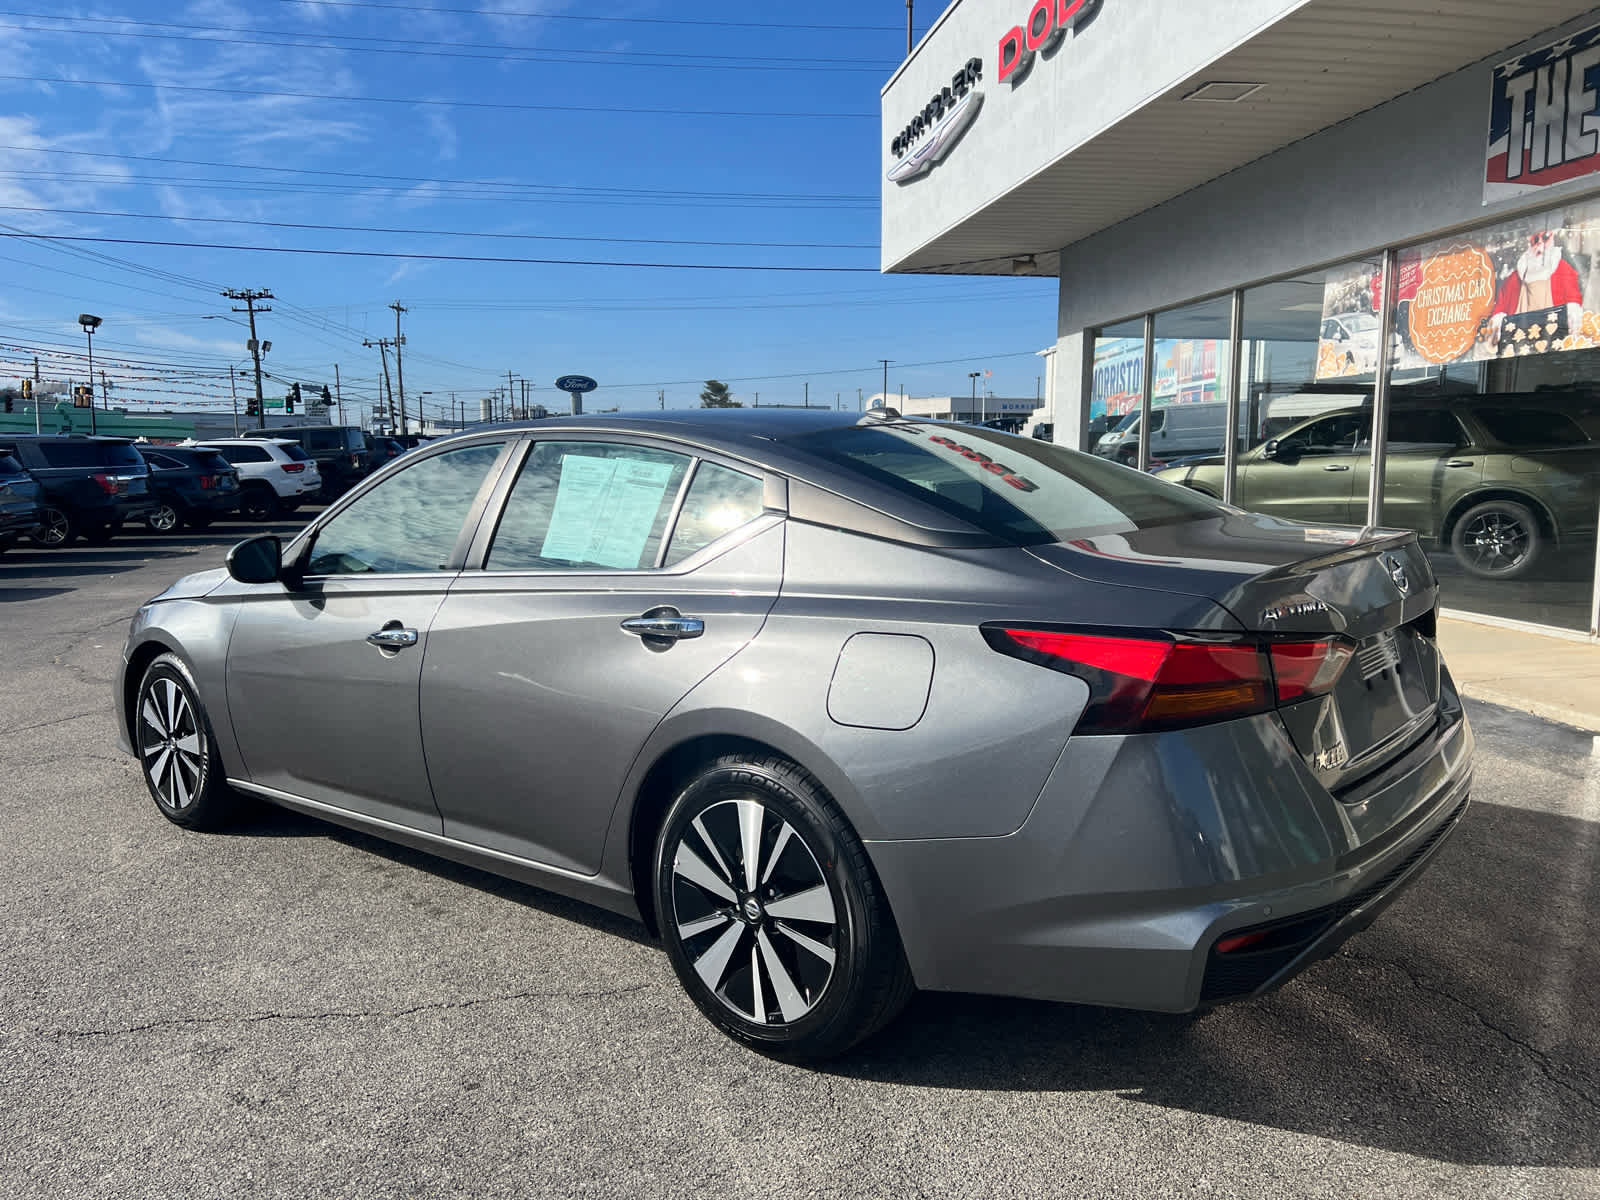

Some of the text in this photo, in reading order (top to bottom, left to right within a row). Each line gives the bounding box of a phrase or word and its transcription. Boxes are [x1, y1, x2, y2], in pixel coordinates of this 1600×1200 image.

[891, 57, 983, 158] CHRYSLER
[1505, 48, 1600, 180] THE
[1417, 281, 1466, 308] CHRISTMAS
[1467, 278, 1487, 300] CAR
[1427, 301, 1473, 327] EXCHANGE
[564, 378, 589, 389] Ford
[1263, 601, 1329, 621] ALTIMA
